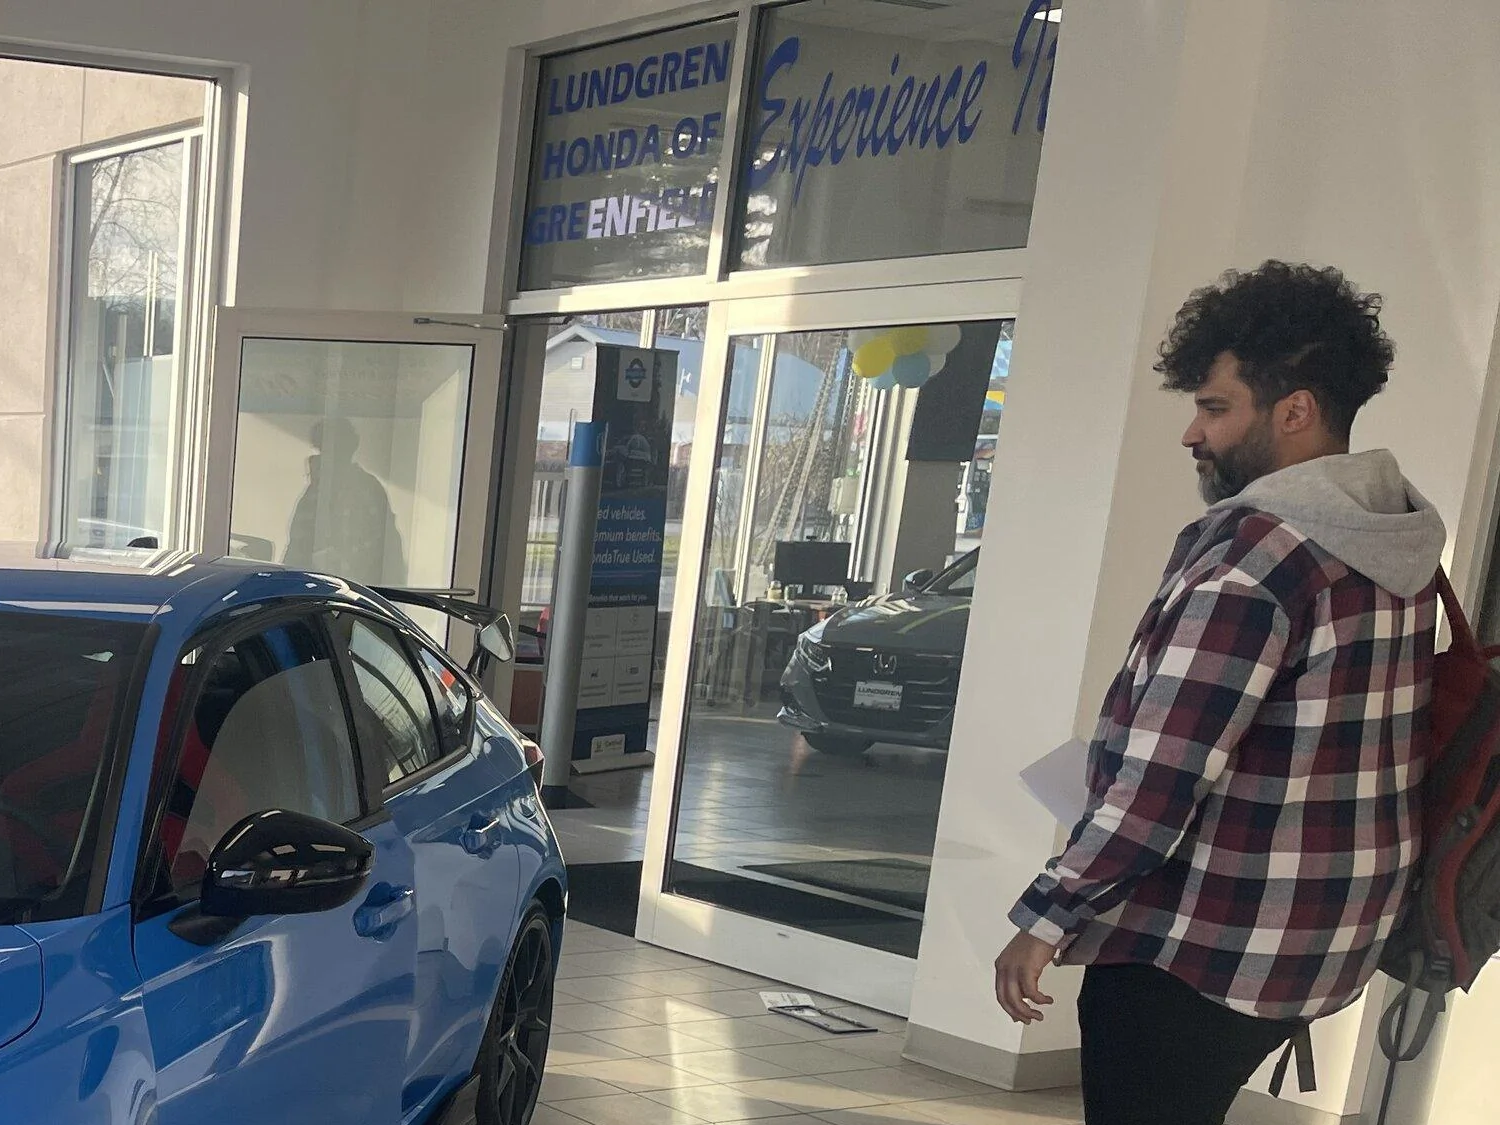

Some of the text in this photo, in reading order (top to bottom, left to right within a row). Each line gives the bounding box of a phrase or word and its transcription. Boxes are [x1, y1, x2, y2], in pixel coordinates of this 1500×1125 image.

[548, 40, 731, 116] LUNDGREN
[543, 112, 721, 181] HONDA OF
[746, 36, 987, 207] Experience
